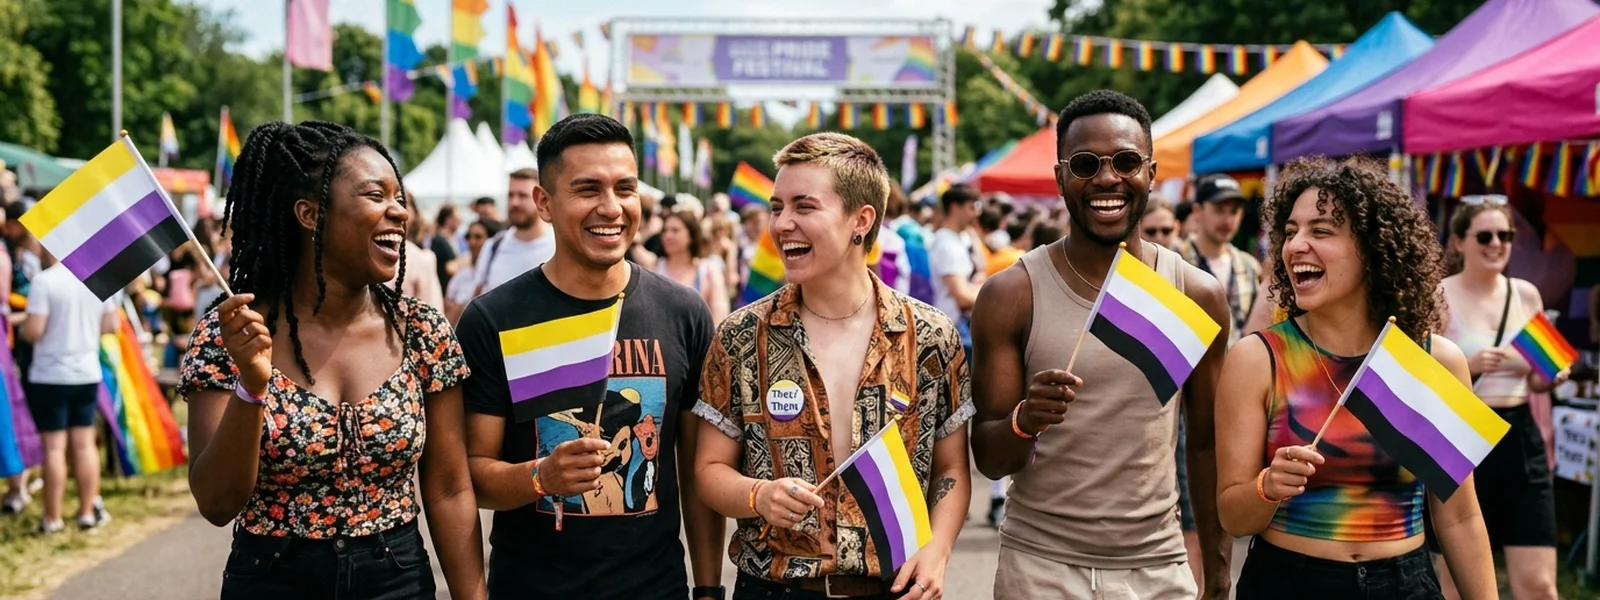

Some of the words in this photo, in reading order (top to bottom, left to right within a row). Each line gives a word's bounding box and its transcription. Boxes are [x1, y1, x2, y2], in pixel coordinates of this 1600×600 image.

[771, 41, 832, 58] PRIDE
[732, 59, 829, 77] FESTIVAL
[770, 401, 799, 412] Them
